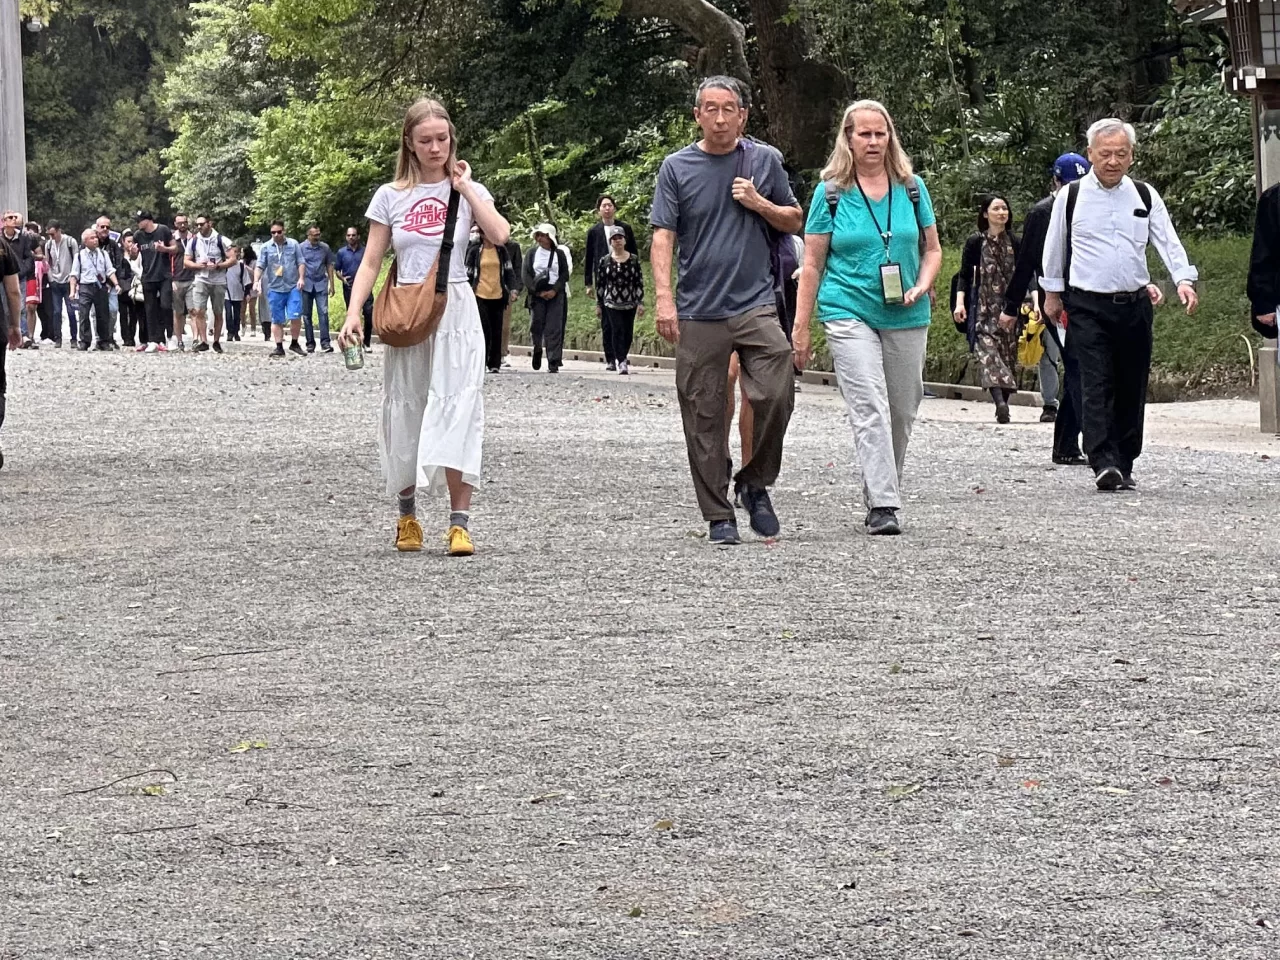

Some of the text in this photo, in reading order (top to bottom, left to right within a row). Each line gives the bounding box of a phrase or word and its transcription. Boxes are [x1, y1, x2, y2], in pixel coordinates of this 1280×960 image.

[1075, 162, 1085, 175] LA
[419, 203, 433, 212] The
[401, 207, 448, 230] Stroke
